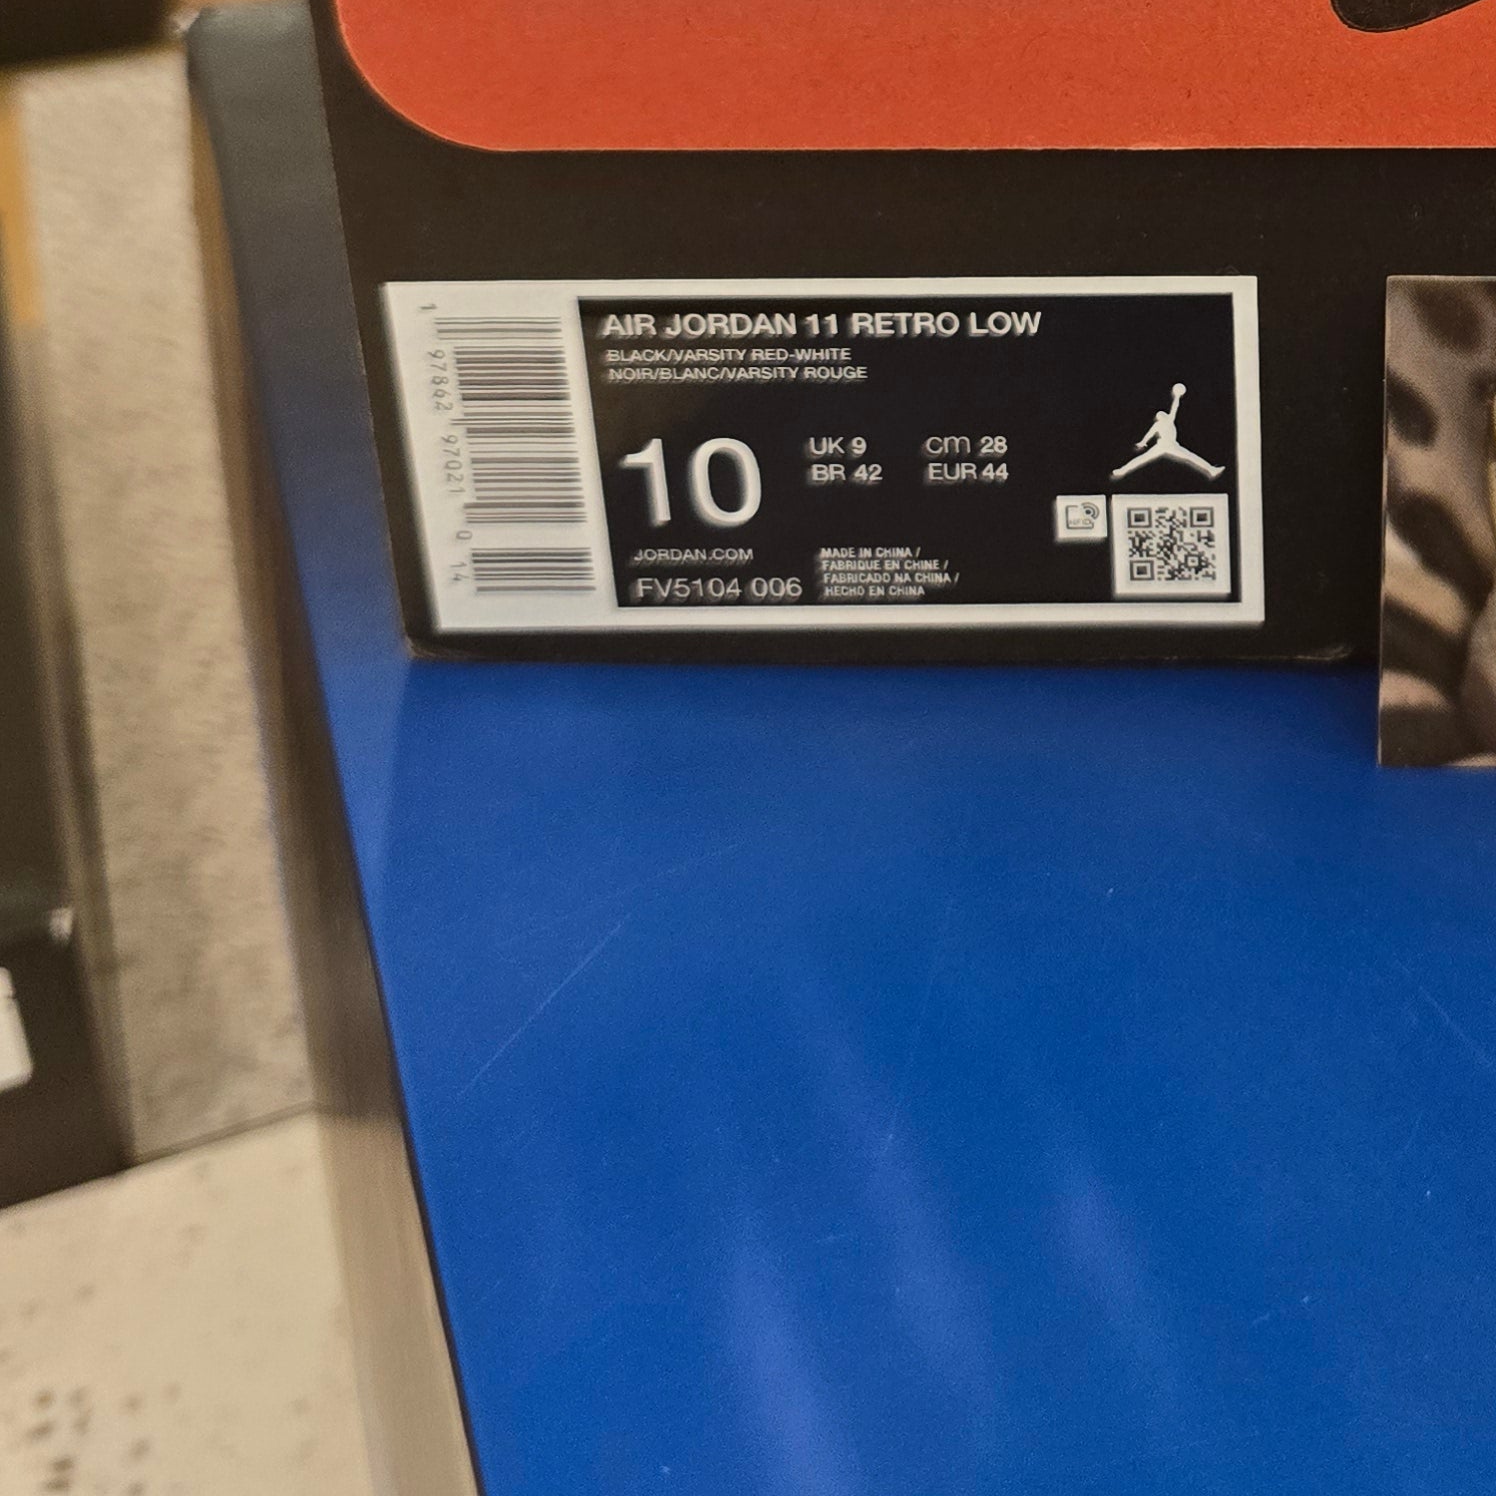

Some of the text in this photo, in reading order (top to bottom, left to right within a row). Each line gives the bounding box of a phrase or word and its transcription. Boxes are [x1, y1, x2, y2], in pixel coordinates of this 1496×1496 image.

[601, 310, 1042, 338] AIR JORDAN 11 RETRO LOW
[606, 347, 852, 364] BLACK/VARSITY RED-WHITE
[608, 366, 869, 382] NOIR/BLANC/VARSITY ROUGE
[427, 349, 454, 412] 97862
[441, 434, 467, 496] 97021
[808, 436, 868, 455] UK 9
[978, 435, 1008, 455] 28
[622, 437, 762, 525] 10
[810, 463, 883, 482] BR 42
[927, 462, 1009, 482] EUR 44
[633, 548, 754, 563] JORDAN.COM
[819, 547, 856, 559] MADE
[858, 547, 872, 558] IN
[875, 547, 913, 558] CHINA
[821, 560, 881, 571] FABRIQUE
[884, 560, 900, 570] EN
[904, 560, 940, 570] CHINE
[634, 577, 803, 599] FV5104 006
[823, 573, 891, 584] FABRICADO
[894, 573, 912, 584] NA
[914, 573, 951, 584] CHINA
[824, 586, 925, 597] HECHO EN CHINA
